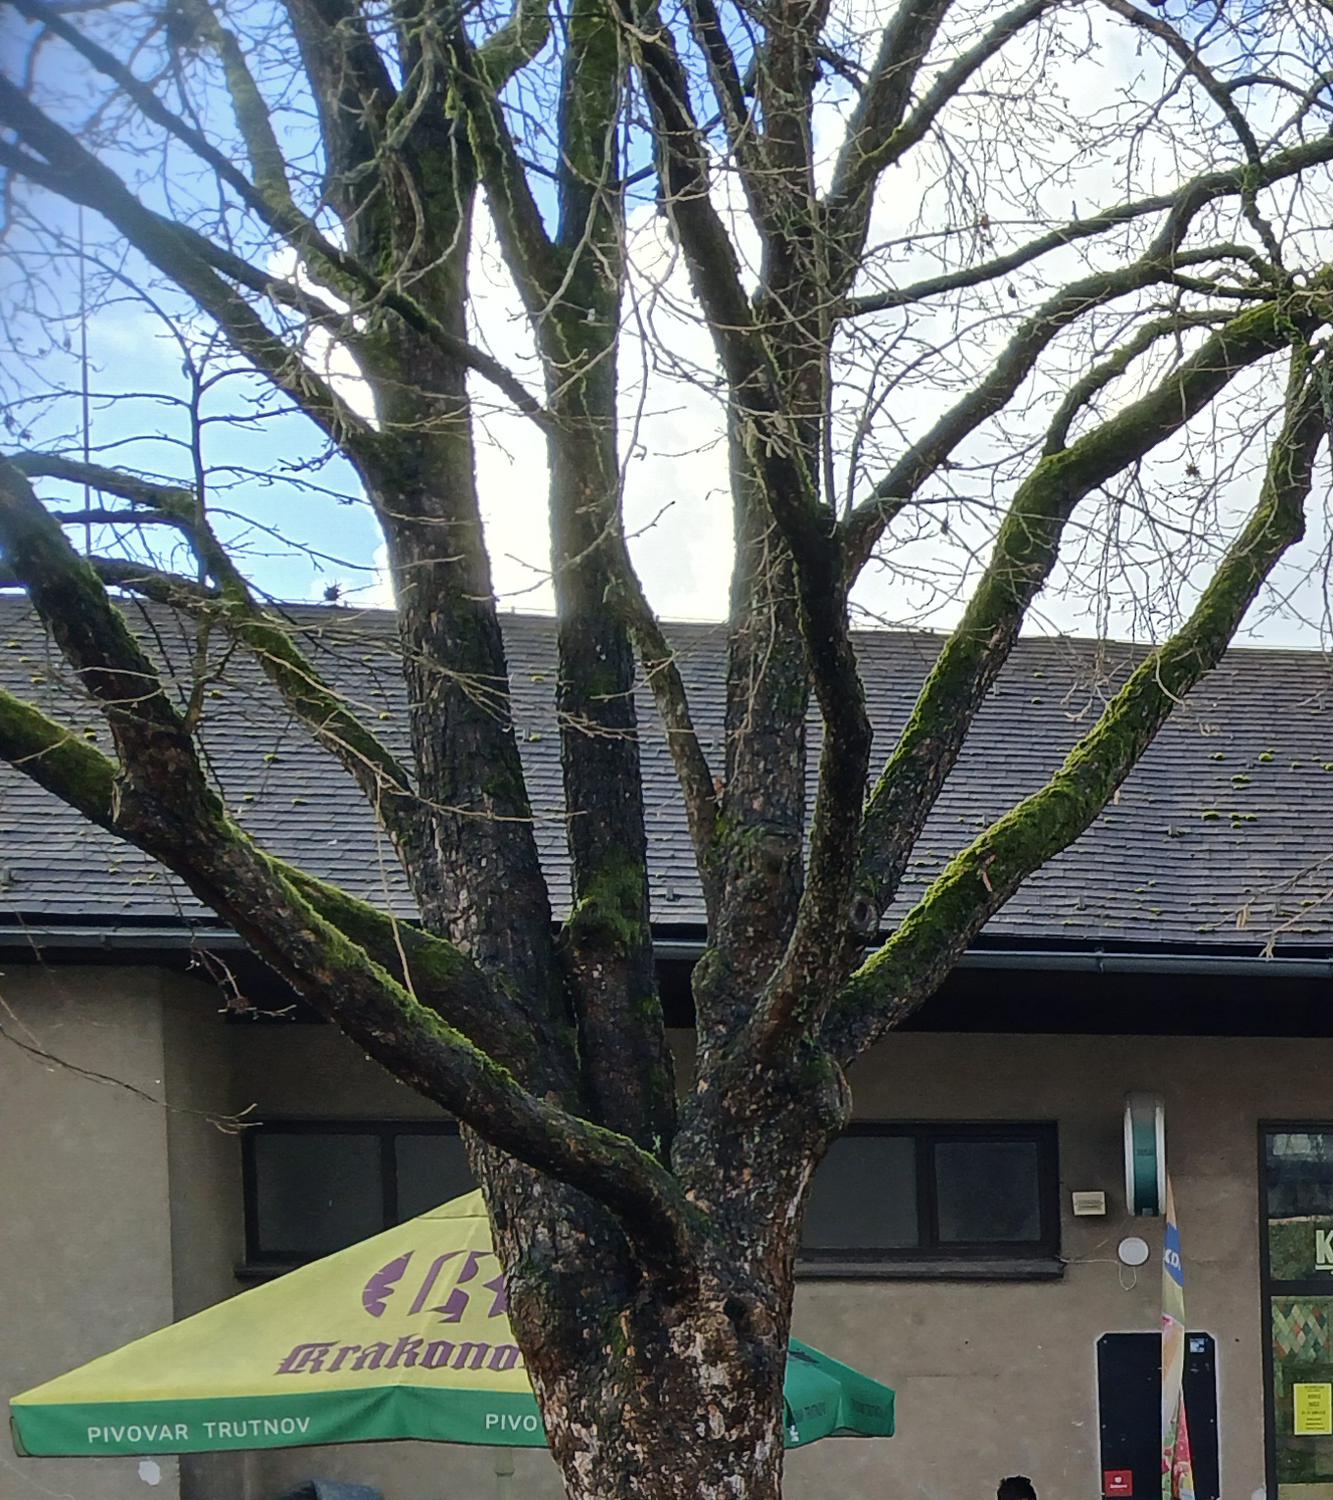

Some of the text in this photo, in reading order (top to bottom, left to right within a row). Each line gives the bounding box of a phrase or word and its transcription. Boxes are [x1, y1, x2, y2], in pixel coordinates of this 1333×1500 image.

[273, 1333, 527, 1376] Krakono
[87, 1417, 311, 1444] PIVOVAR TRUTNOV
